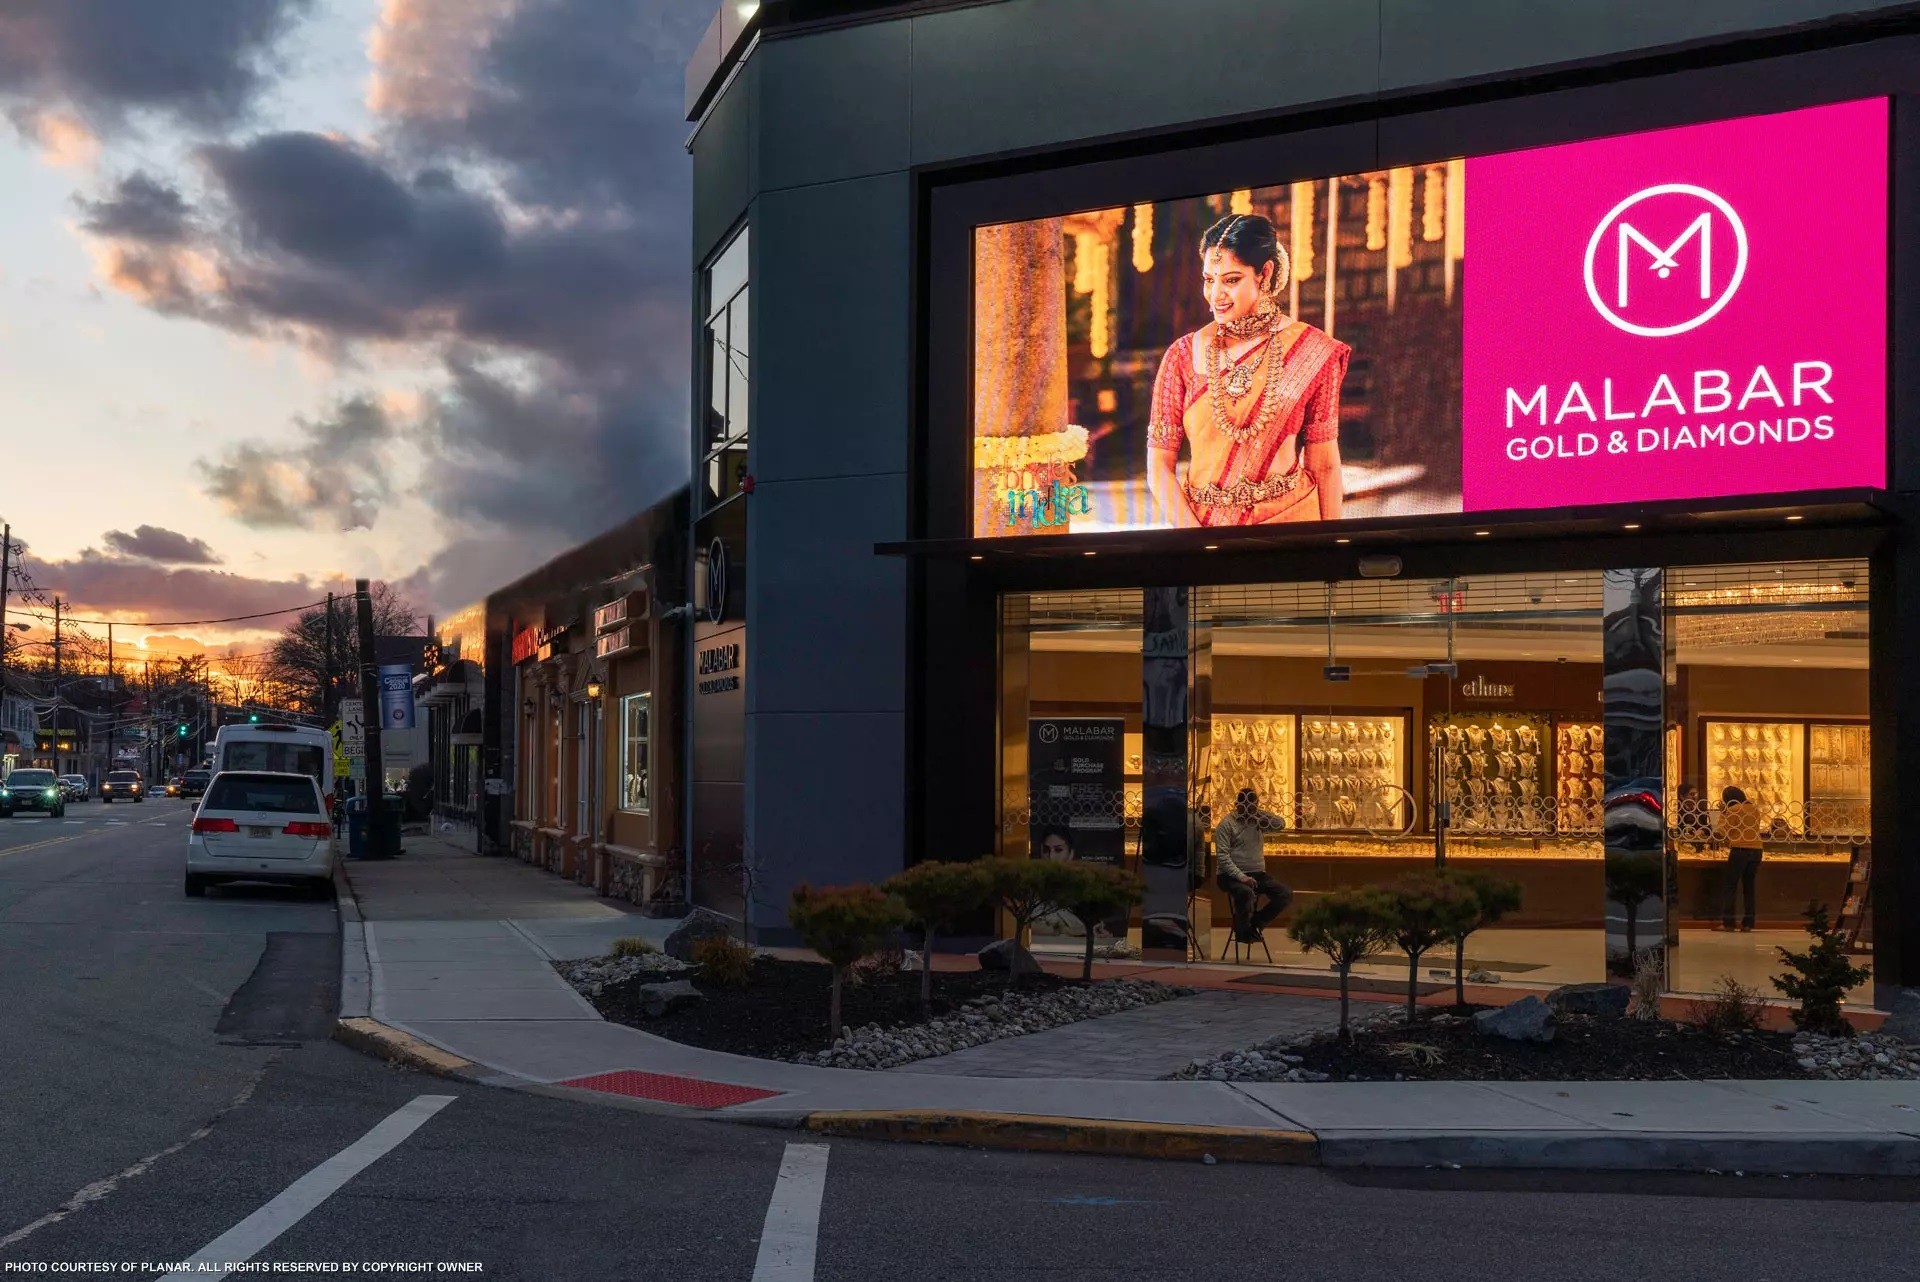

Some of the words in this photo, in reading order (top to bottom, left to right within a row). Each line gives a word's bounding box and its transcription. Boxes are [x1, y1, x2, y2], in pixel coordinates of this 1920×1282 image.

[1505, 360, 1835, 429] MALABAR
[1505, 432, 1600, 461] GOLD
[1607, 430, 1629, 454] &
[1636, 415, 1835, 453] DIAMONDS
[699, 643, 736, 674] MALABAR
[1063, 726, 1115, 735] MALABAR
[1071, 782, 1104, 793] FREE
